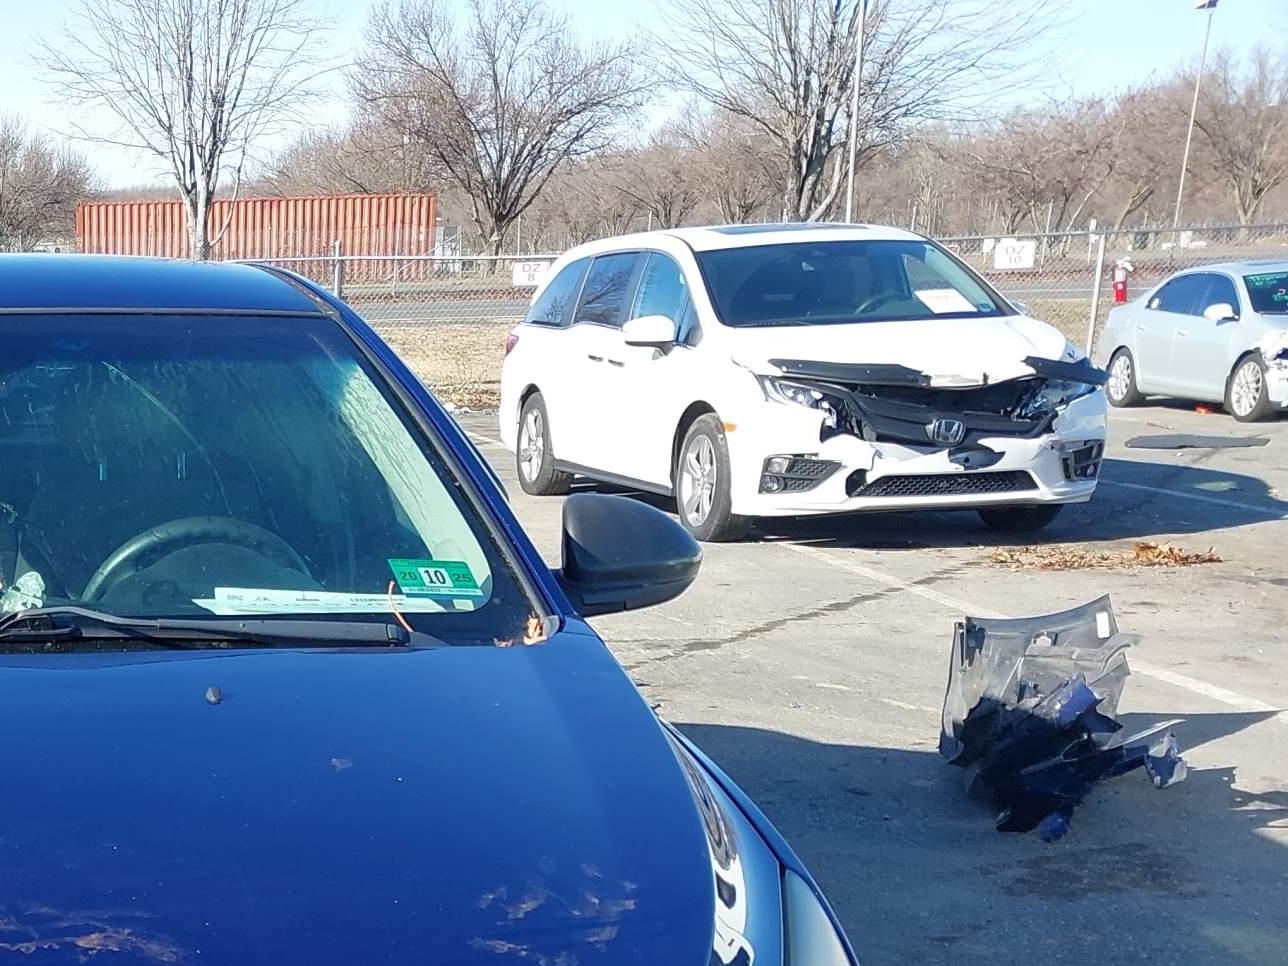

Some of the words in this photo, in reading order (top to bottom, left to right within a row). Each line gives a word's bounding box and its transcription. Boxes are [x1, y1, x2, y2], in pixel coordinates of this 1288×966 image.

[522, 263, 542, 273] DZ
[399, 571, 418, 581] 20
[423, 569, 446, 585] 10
[452, 572, 473, 583] 25
